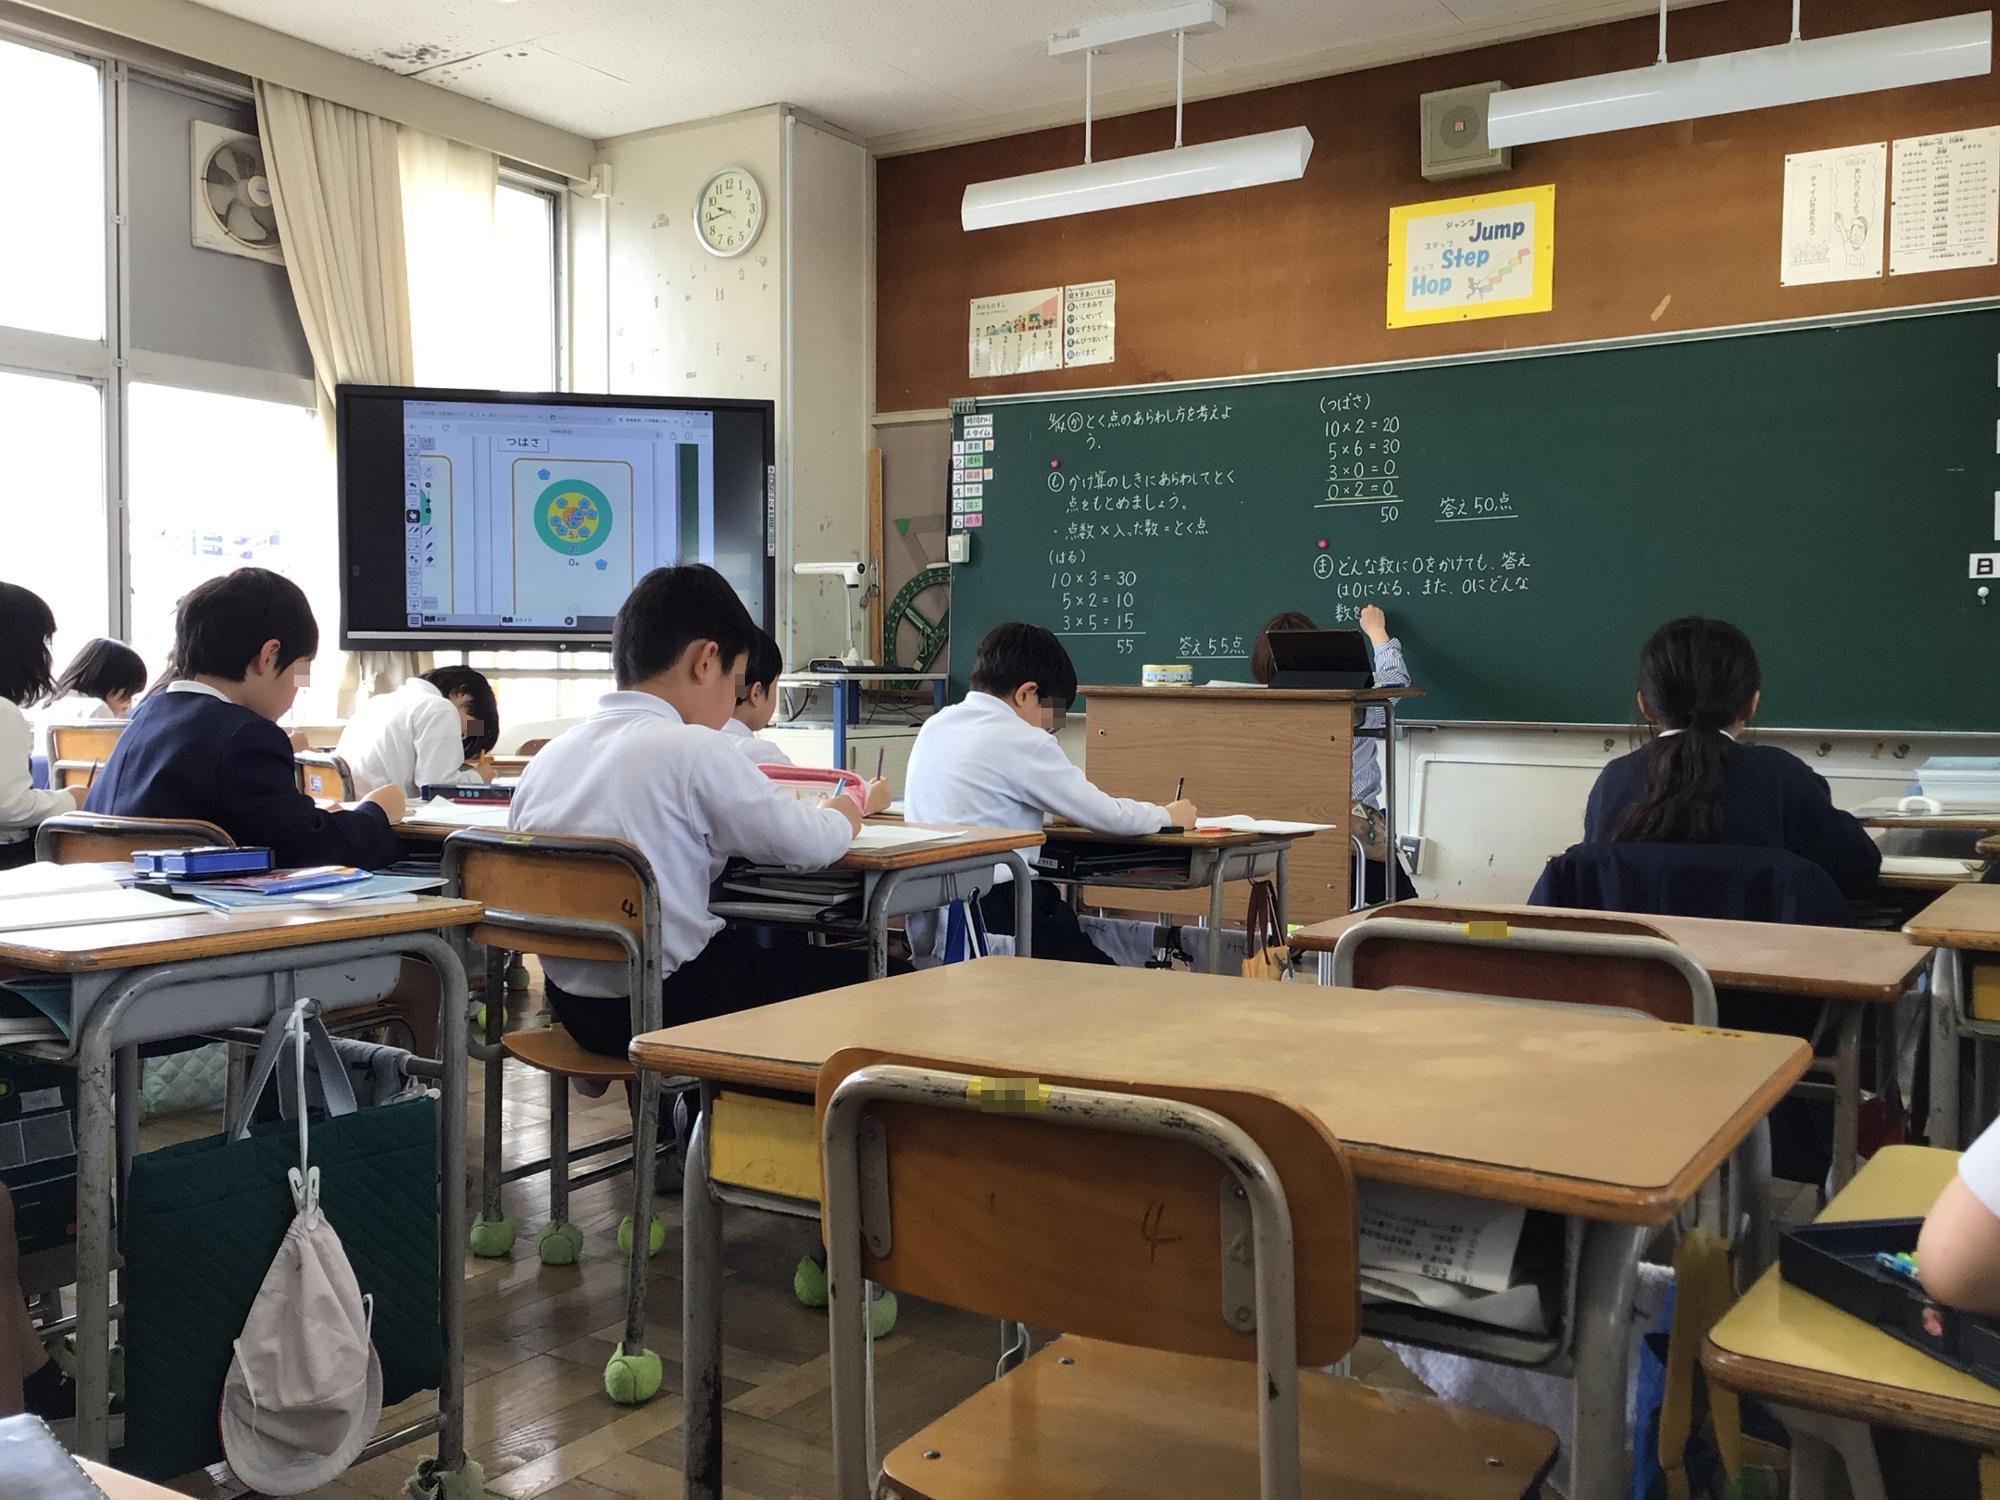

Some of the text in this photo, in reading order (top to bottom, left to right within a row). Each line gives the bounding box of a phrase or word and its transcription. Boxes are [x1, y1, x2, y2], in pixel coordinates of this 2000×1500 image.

[715, 184, 723, 195] 11
[725, 178, 734, 190] 12
[739, 180, 742, 191] 1
[745, 189, 752, 200] 2
[708, 196, 717, 207] 10
[749, 203, 756, 214] 3
[709, 225, 716, 236] 8
[739, 231, 744, 241] 5
[1469, 221, 1526, 243] Jump
[718, 234, 723, 245] 7
[727, 235, 734, 246] 6
[1441, 248, 1490, 269] Step
[1411, 275, 1452, 297] Hop
[955, 459, 961, 468] 2
[955, 472, 962, 482] 3
[1068, 470, 1236, 492] かけ算のしきにあらわしてとく
[955, 487, 961, 496] 4
[955, 503, 962, 512] 5
[1380, 506, 1399, 523] 50
[955, 519, 962, 528] 6
[1117, 639, 1134, 654] 55
[621, 899, 638, 918] 4
[1142, 1200, 1184, 1263] 4
